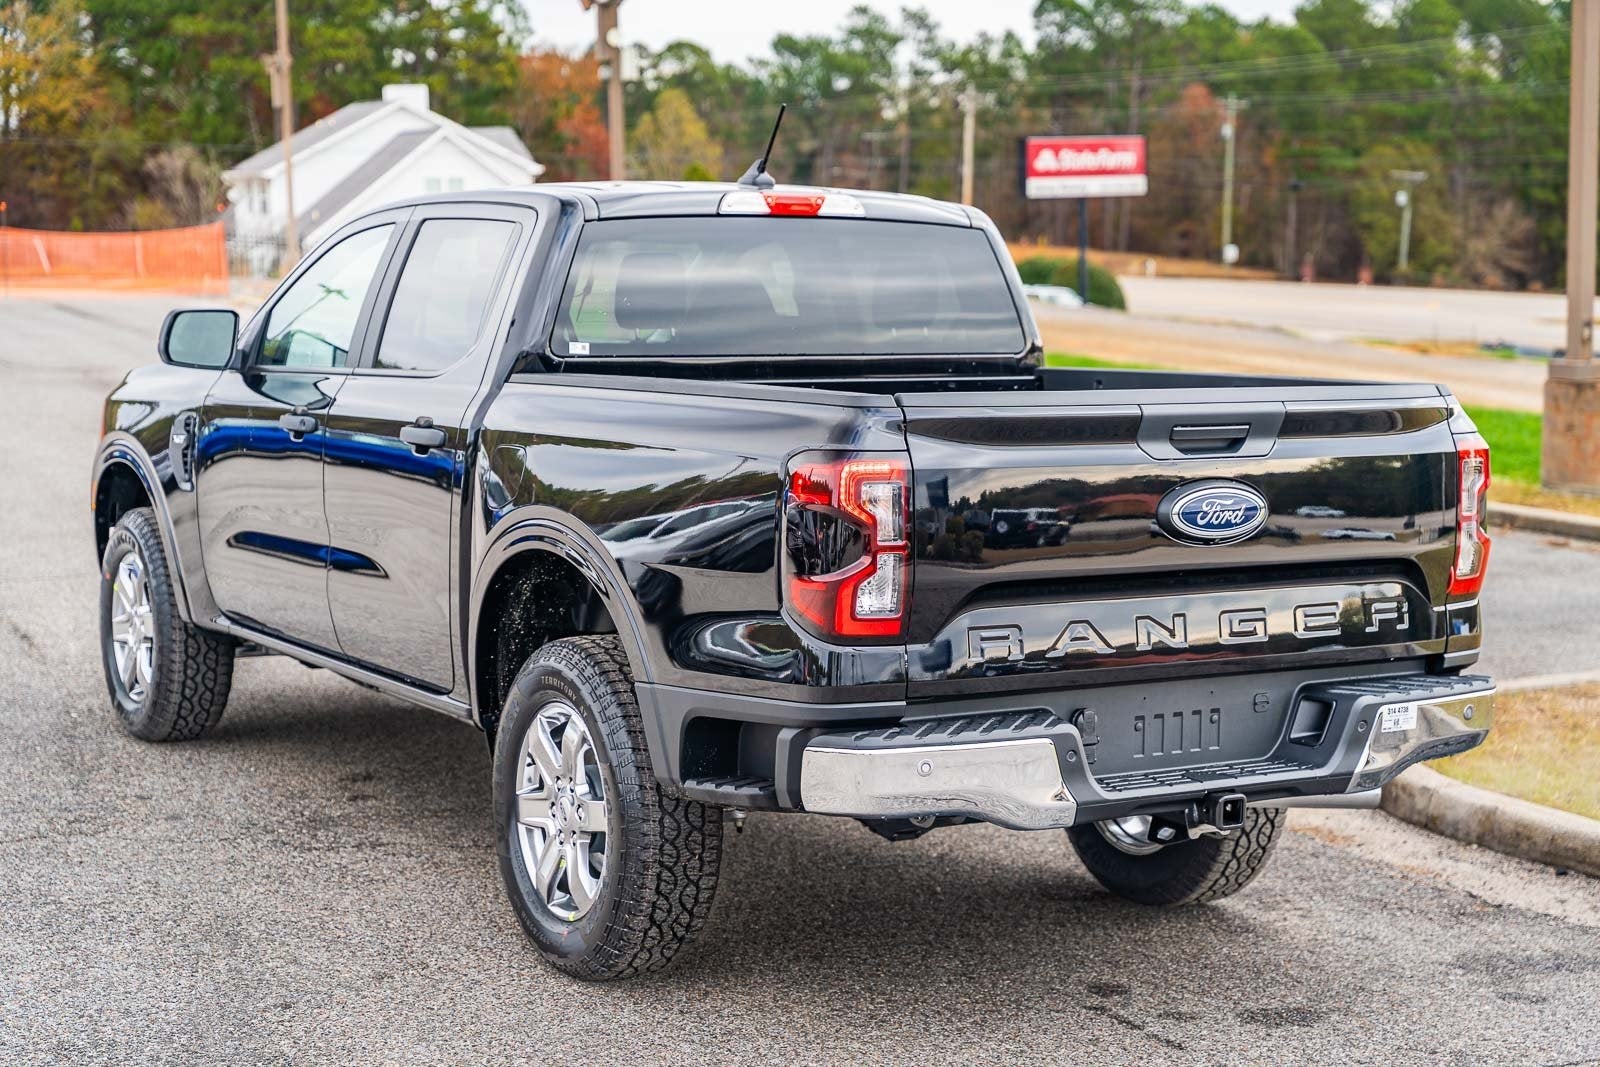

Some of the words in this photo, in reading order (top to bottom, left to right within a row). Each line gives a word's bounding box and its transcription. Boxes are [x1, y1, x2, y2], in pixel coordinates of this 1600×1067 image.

[1197, 498, 1247, 526] Ford
[966, 596, 1409, 663] RANGER
[540, 675, 577, 702] TERRITORY
